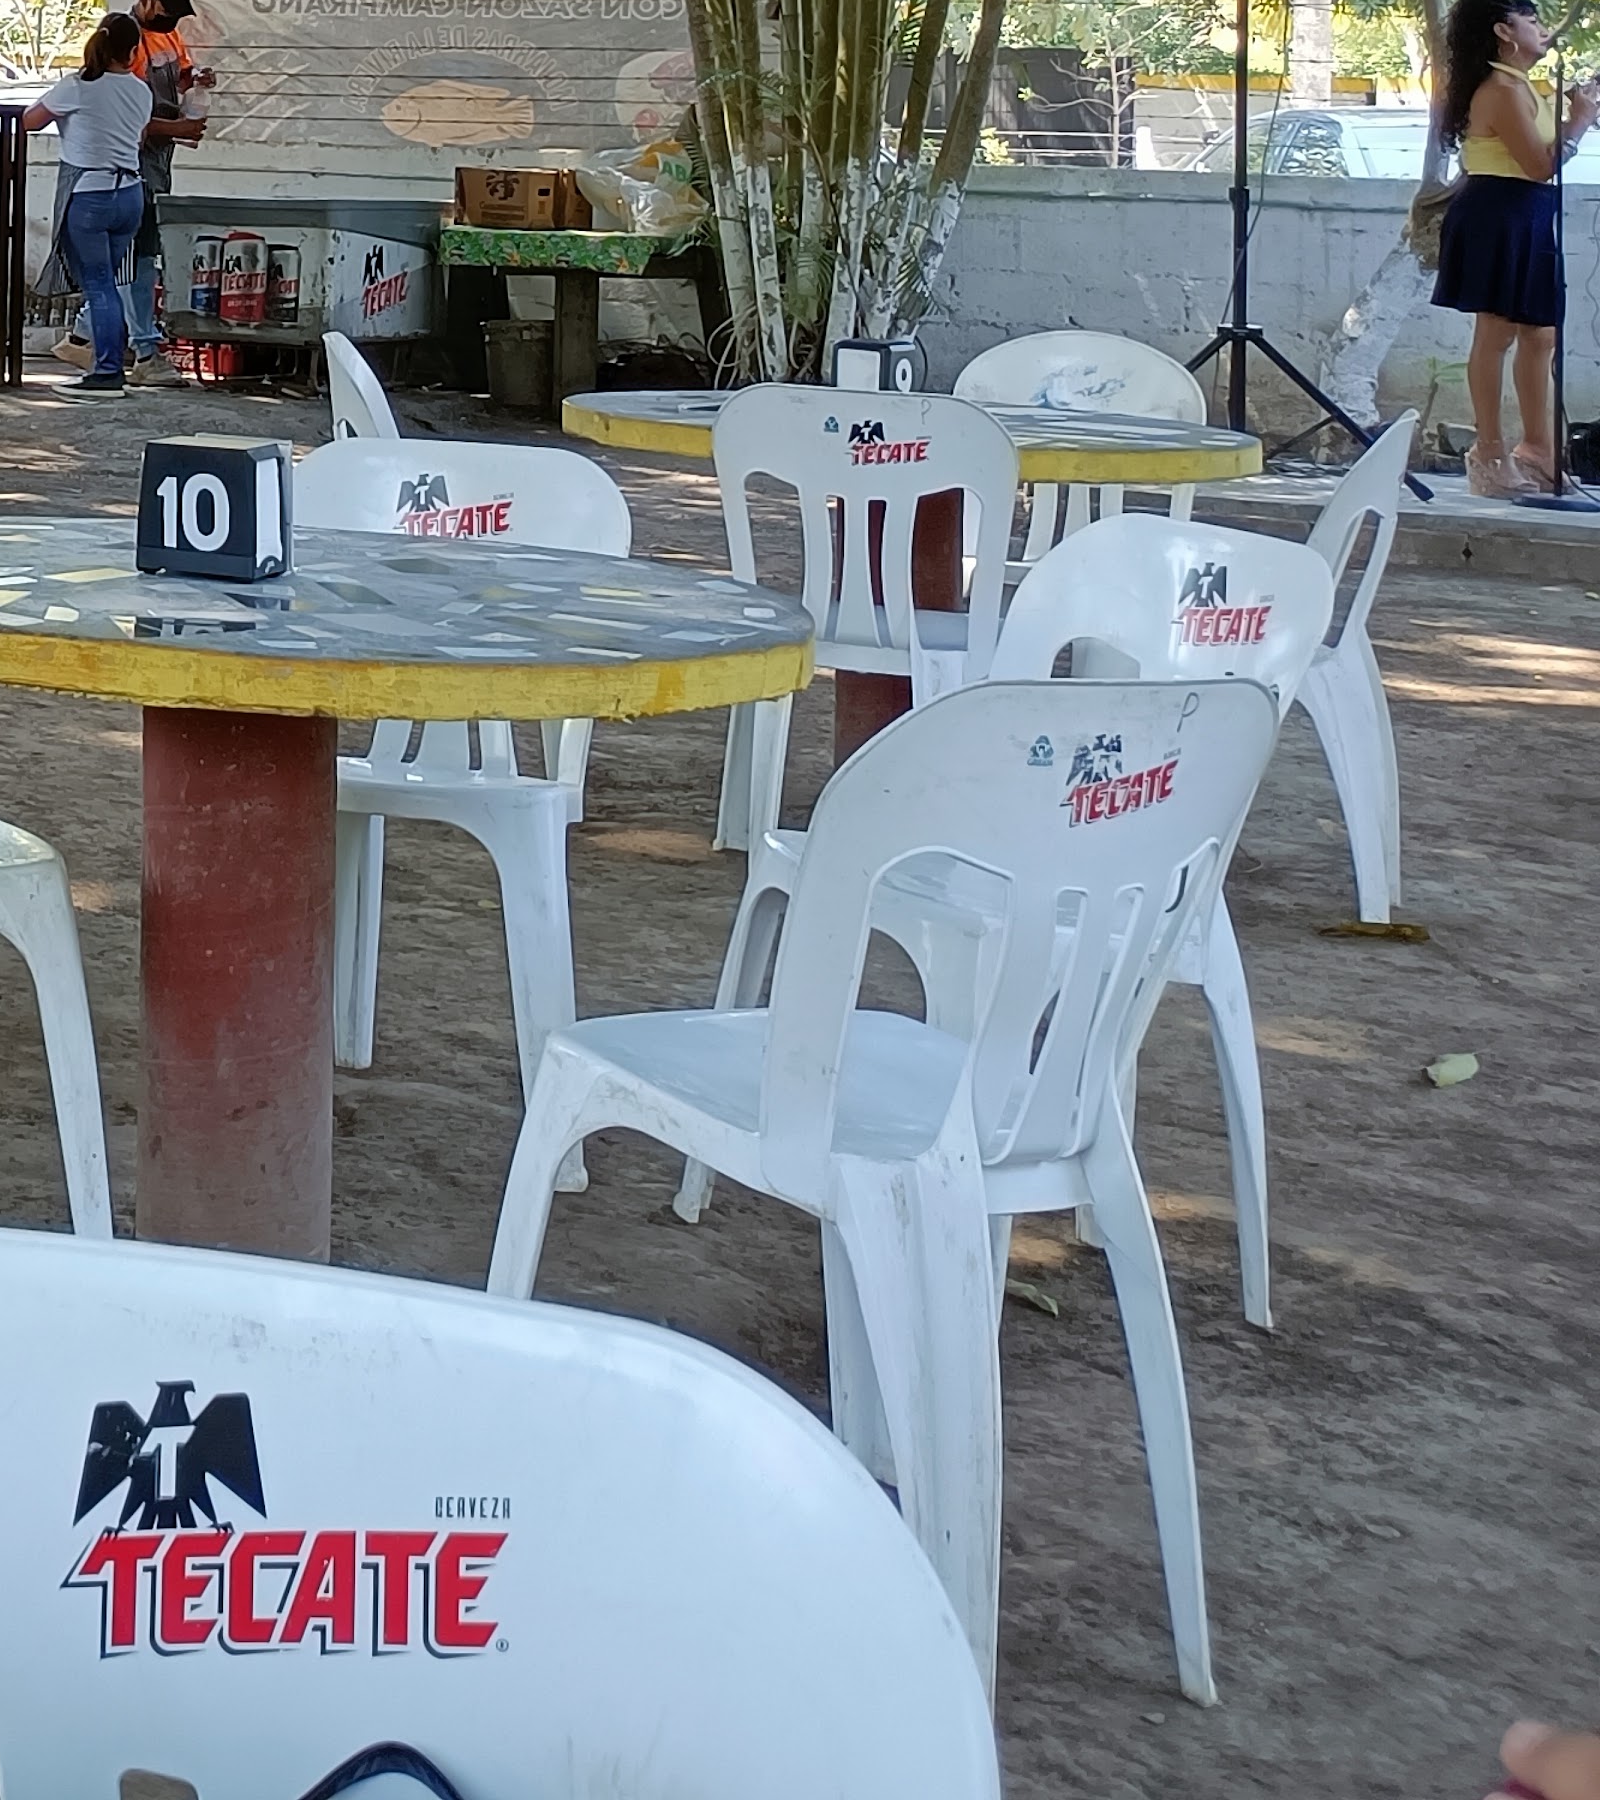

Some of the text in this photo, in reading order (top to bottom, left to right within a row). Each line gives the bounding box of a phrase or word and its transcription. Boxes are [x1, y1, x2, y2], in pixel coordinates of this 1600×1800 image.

[360, 271, 409, 318] TECATE
[845, 440, 931, 465] TECATE
[156, 473, 230, 552] 10
[392, 501, 513, 538] TECATE
[1170, 605, 1273, 646] TECATE
[1060, 759, 1180, 827] TECATE
[435, 1496, 511, 1519] CERVEZA
[60, 1530, 510, 1660] TECATE
